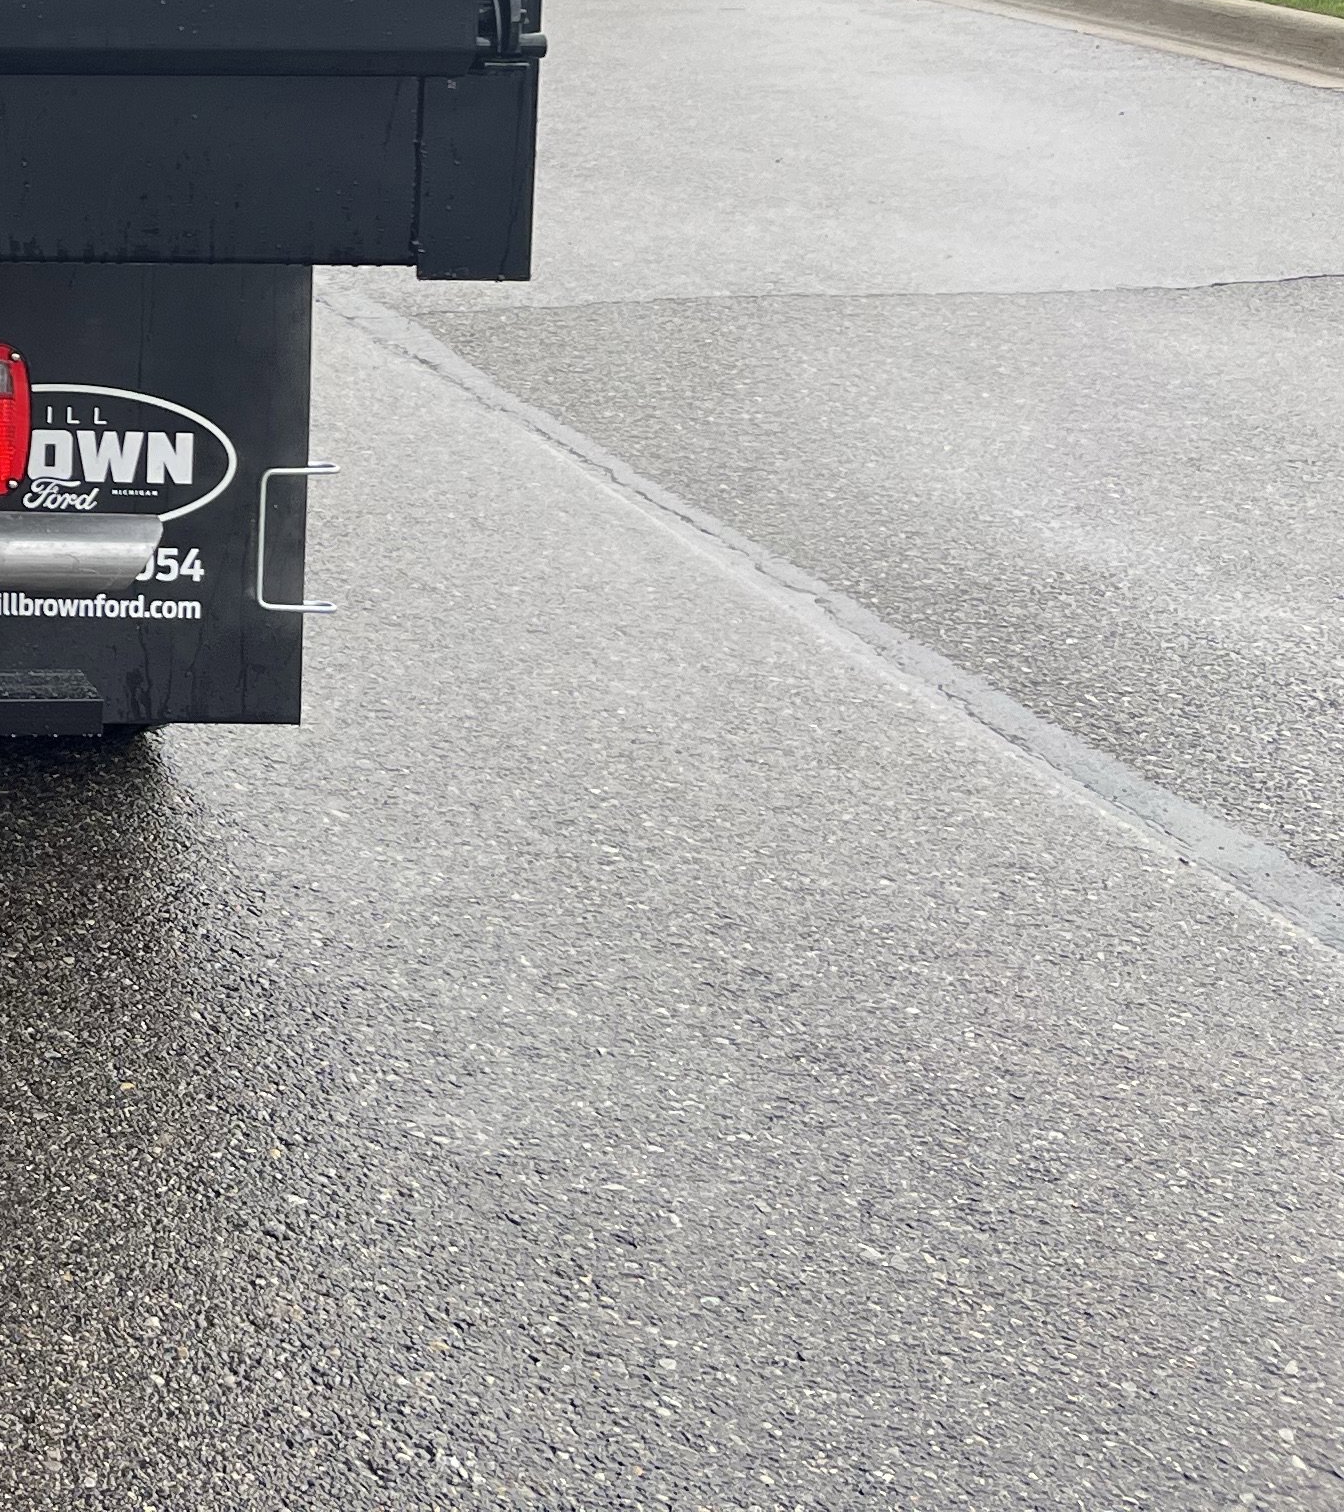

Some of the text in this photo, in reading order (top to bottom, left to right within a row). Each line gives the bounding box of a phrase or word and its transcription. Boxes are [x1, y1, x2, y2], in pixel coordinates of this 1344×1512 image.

[46, 405, 108, 425] ILL
[27, 429, 194, 485] OWN
[22, 478, 100, 510] Ford
[112, 489, 159, 497] MICHIGAN
